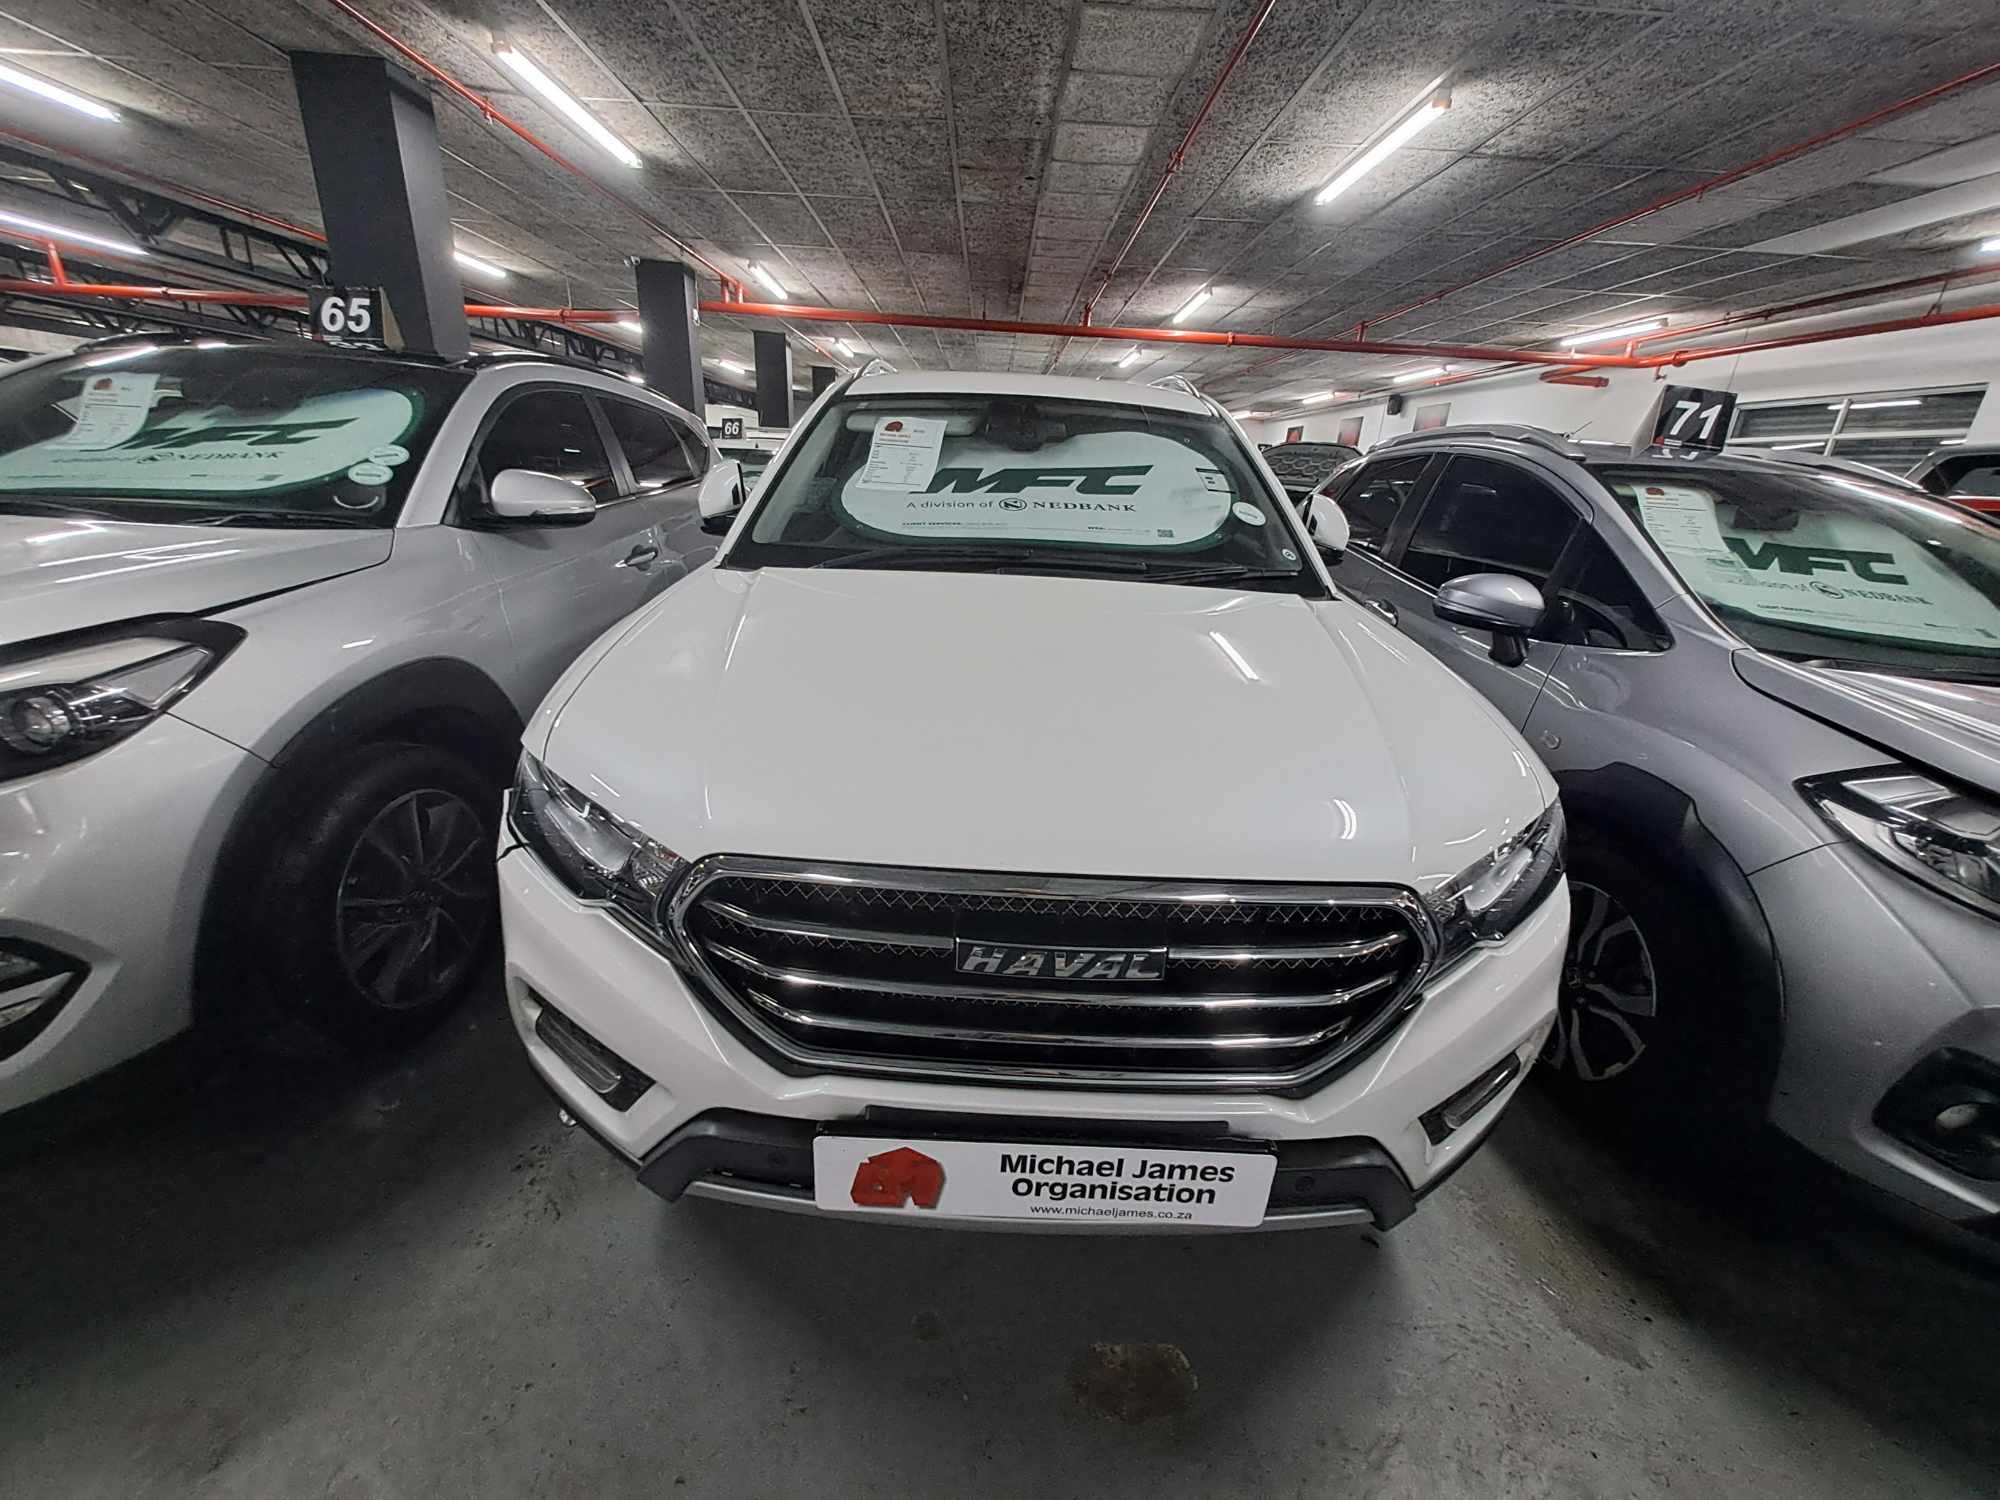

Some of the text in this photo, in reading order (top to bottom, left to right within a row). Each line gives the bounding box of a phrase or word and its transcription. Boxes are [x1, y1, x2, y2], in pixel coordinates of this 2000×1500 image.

[320, 296, 371, 333] 65
[724, 421, 740, 435] 66
[1669, 400, 1723, 440] 71
[908, 465, 1154, 495] MFC
[906, 501, 916, 509] A
[920, 500, 974, 509] division
[978, 500, 994, 509] of
[1032, 501, 1137, 512] NEDBANK
[962, 945, 1160, 979] HAVAL
[1000, 1154, 1236, 1183] Michael James
[1011, 1177, 1217, 1205] Organisation
[1030, 1205, 1193, 1221] www.michaeljames.co.za
